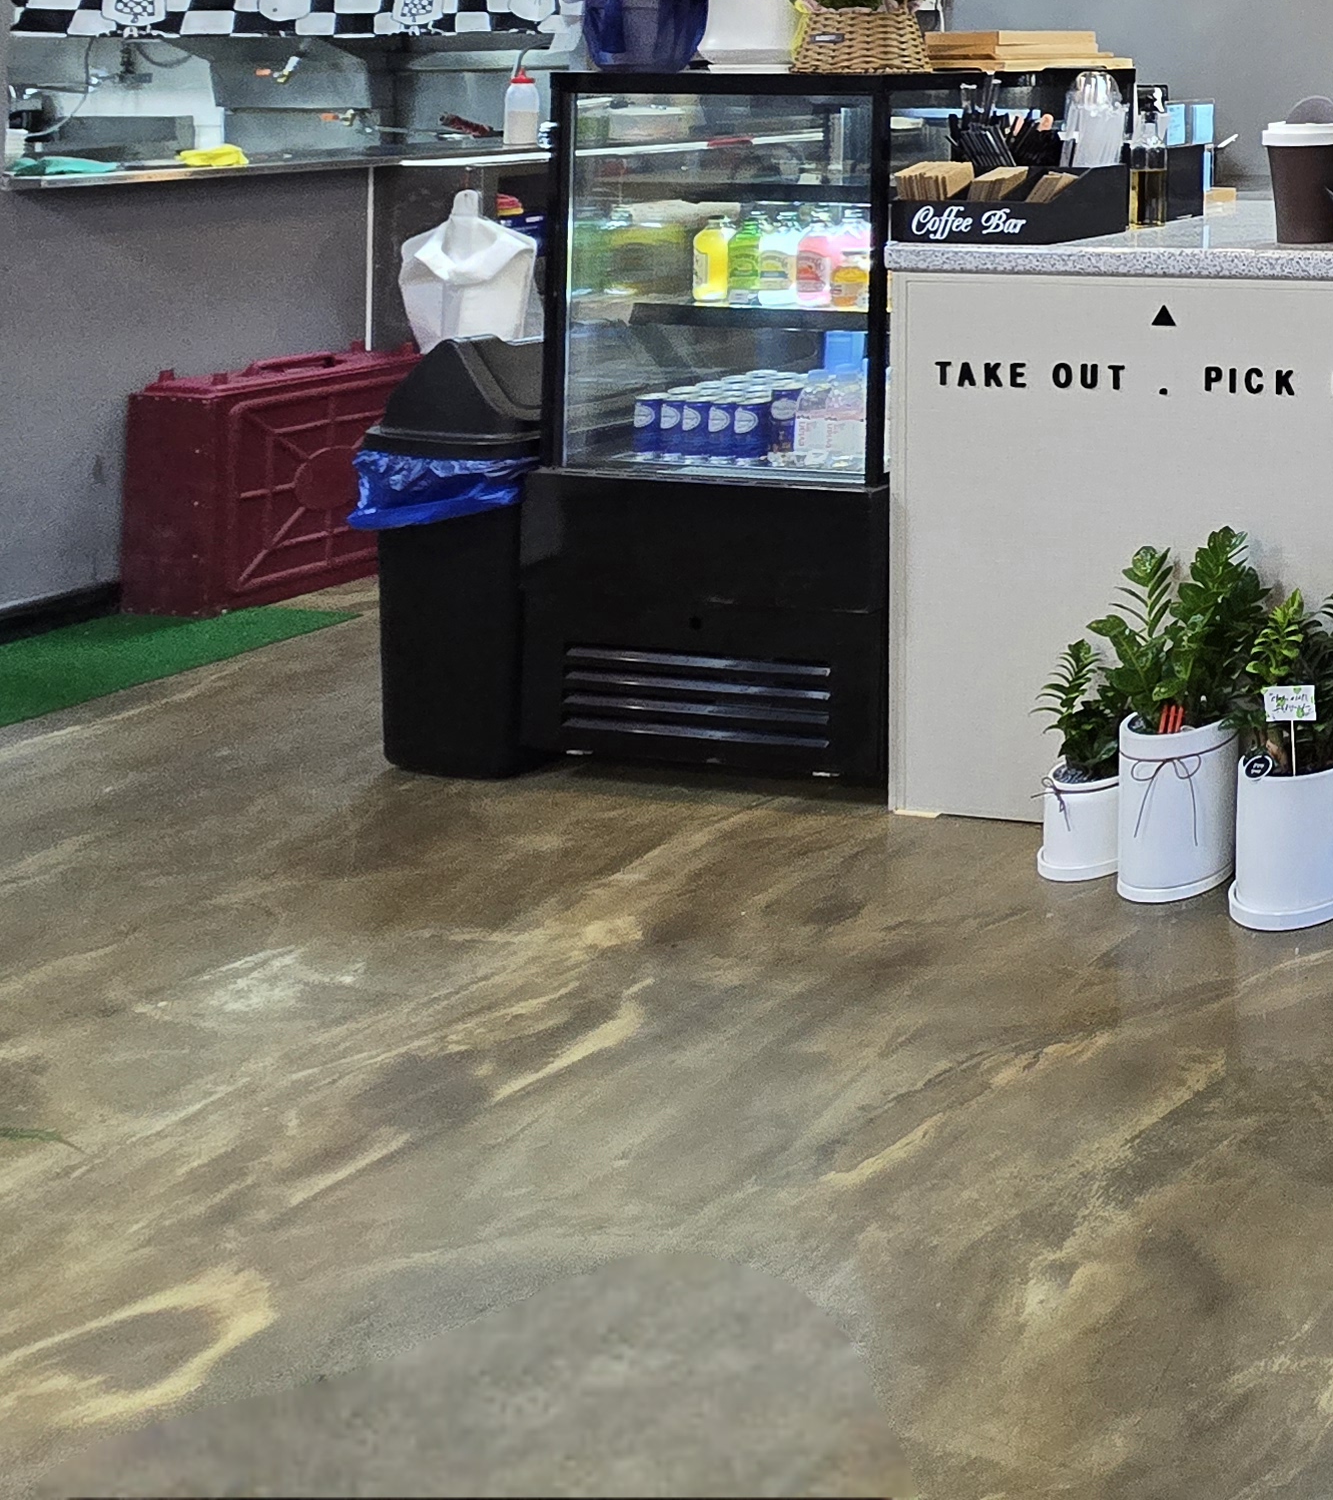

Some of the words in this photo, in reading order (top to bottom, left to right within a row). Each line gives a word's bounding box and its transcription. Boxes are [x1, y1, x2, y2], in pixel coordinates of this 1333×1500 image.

[911, 205, 974, 240] Coffee
[981, 208, 1027, 235] Bar
[934, 360, 1028, 389] TAKE
[1051, 362, 1127, 391] OUT
[1204, 365, 1296, 397] PICK
